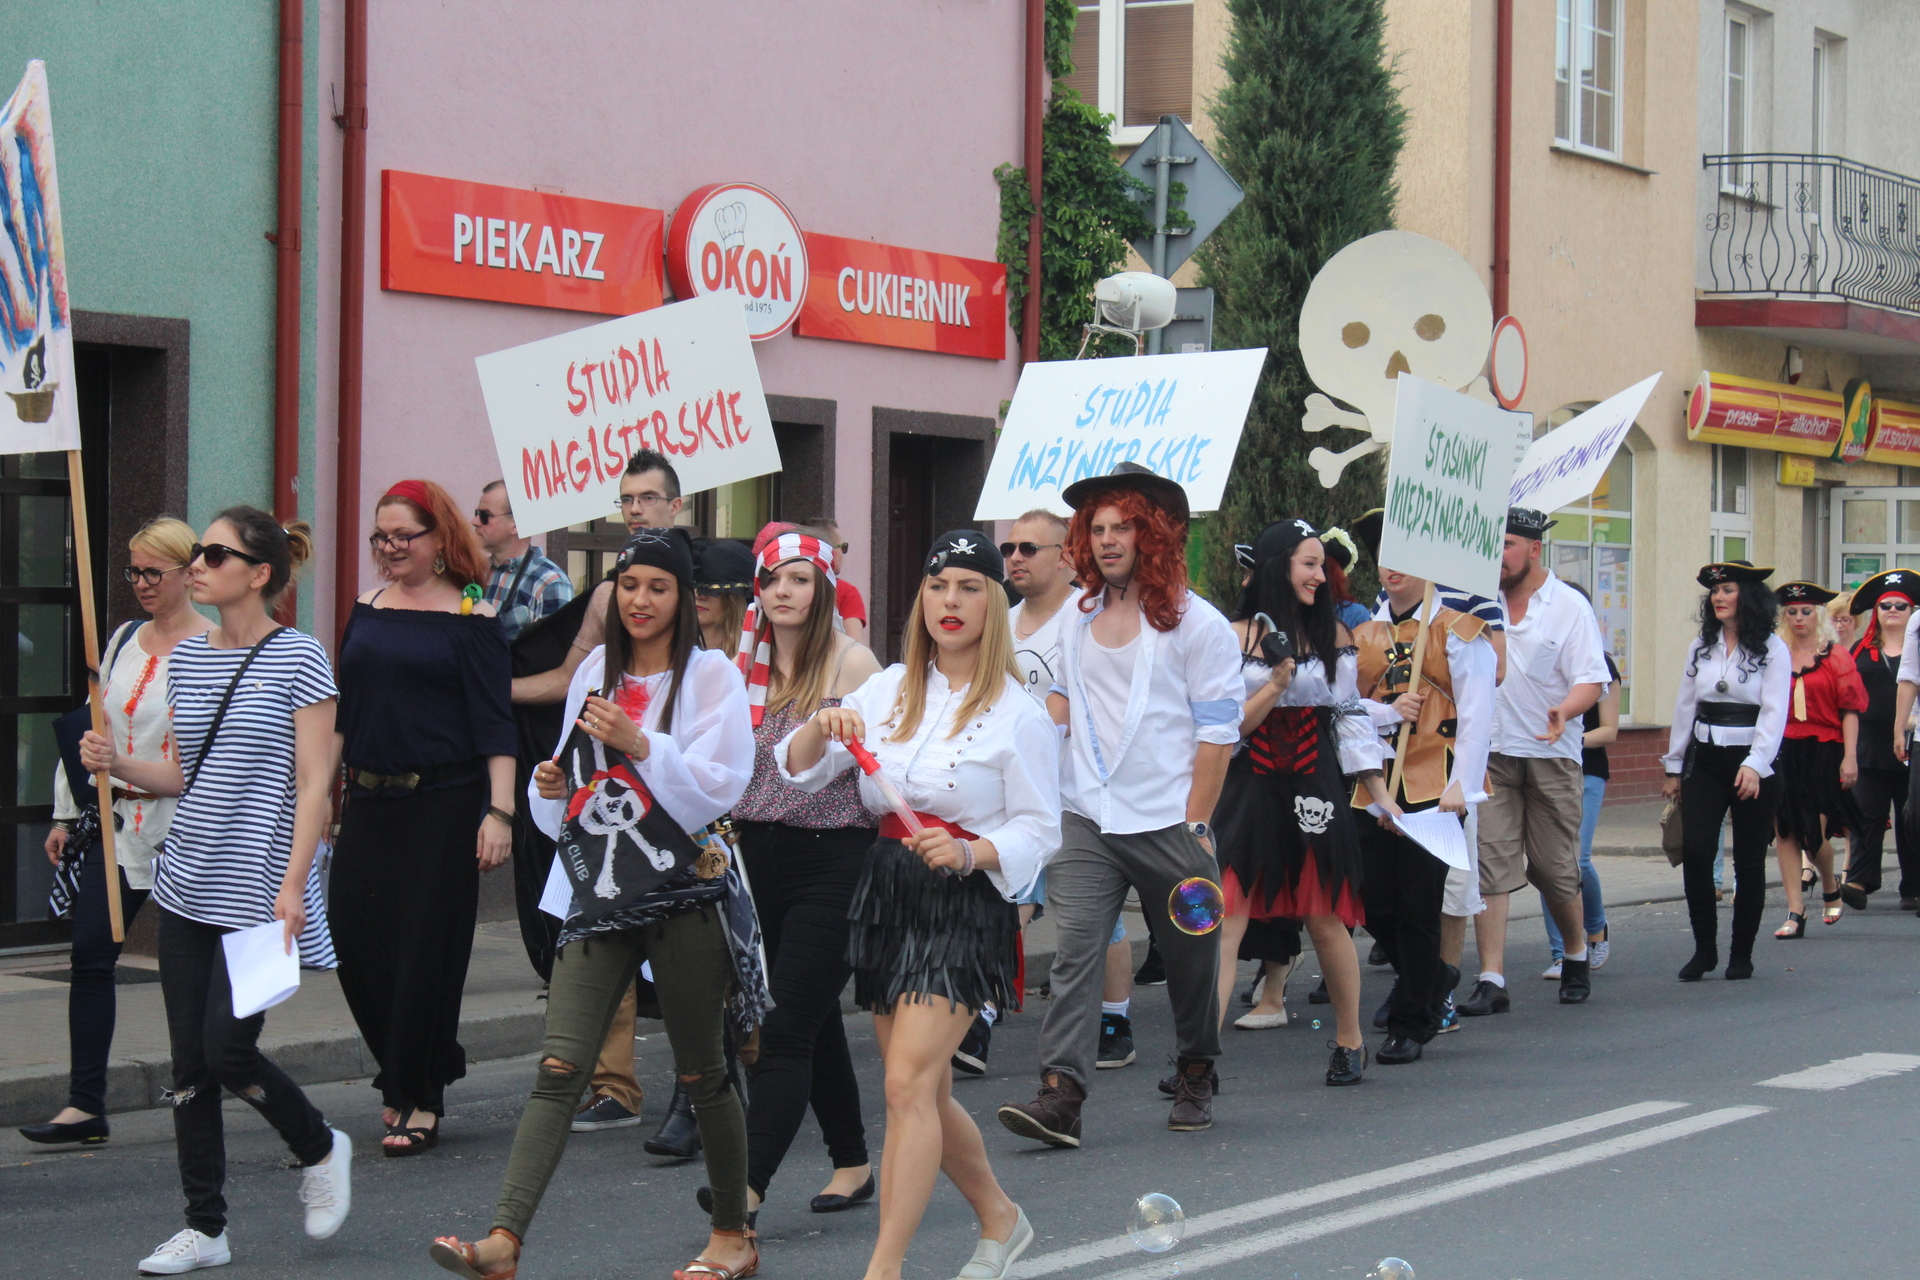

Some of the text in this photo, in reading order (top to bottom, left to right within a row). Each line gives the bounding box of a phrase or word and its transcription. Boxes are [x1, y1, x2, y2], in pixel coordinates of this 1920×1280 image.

[453, 213, 606, 281] PIEKARZ
[701, 241, 792, 303] OKOŃ
[744, 301, 772, 315] od 1975
[837, 266, 971, 328] CUKIERNIK
[566, 335, 671, 417] STUDIA
[1075, 378, 1179, 431] STUDIA
[522, 388, 753, 501] MAGISTERSKIE
[1722, 409, 1760, 428] prasa
[1789, 413, 1831, 437] alkohol
[1425, 422, 1490, 492] STOSUNKI
[1389, 474, 1504, 561] MIĘDZYNARODOWE
[567, 844, 590, 882] CLUB
